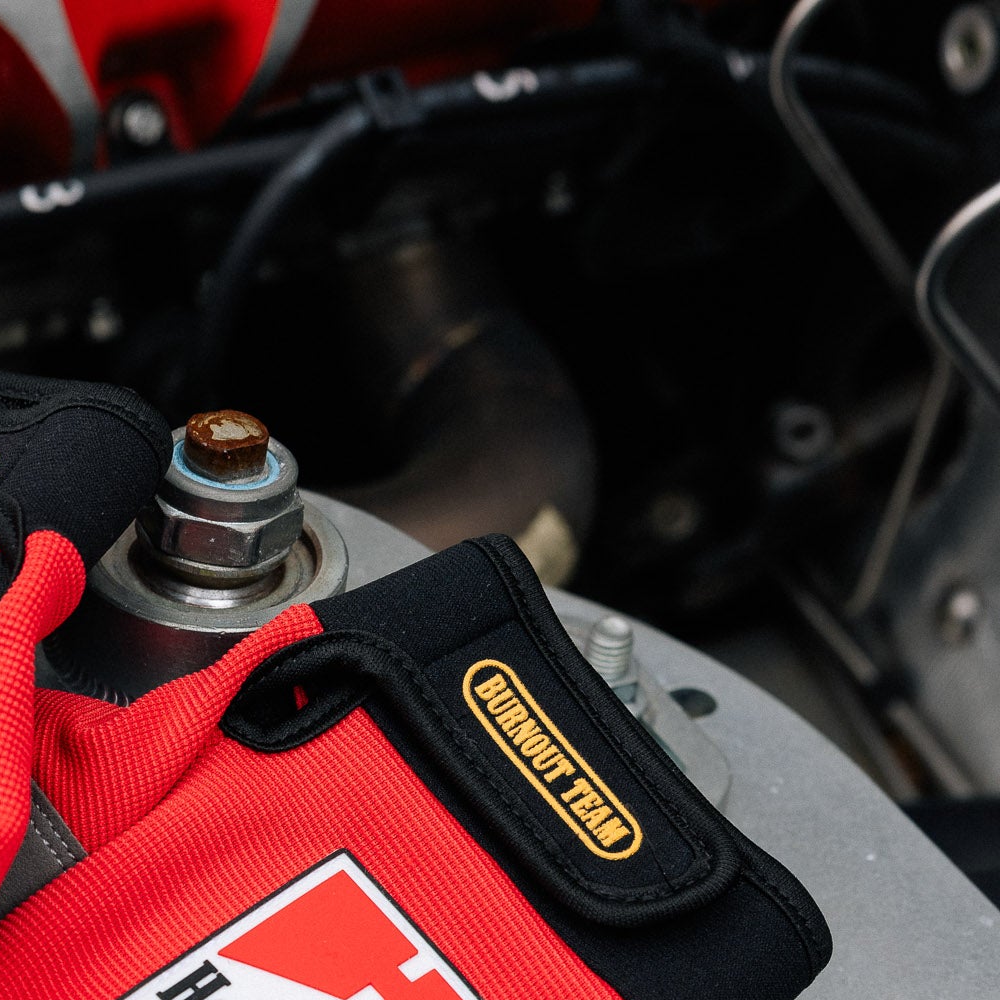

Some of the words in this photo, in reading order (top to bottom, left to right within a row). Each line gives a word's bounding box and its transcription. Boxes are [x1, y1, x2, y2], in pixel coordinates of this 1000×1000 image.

[20, 179, 85, 213] 3
[474, 673, 577, 784] BURNOUT
[560, 777, 632, 848] TEAM
